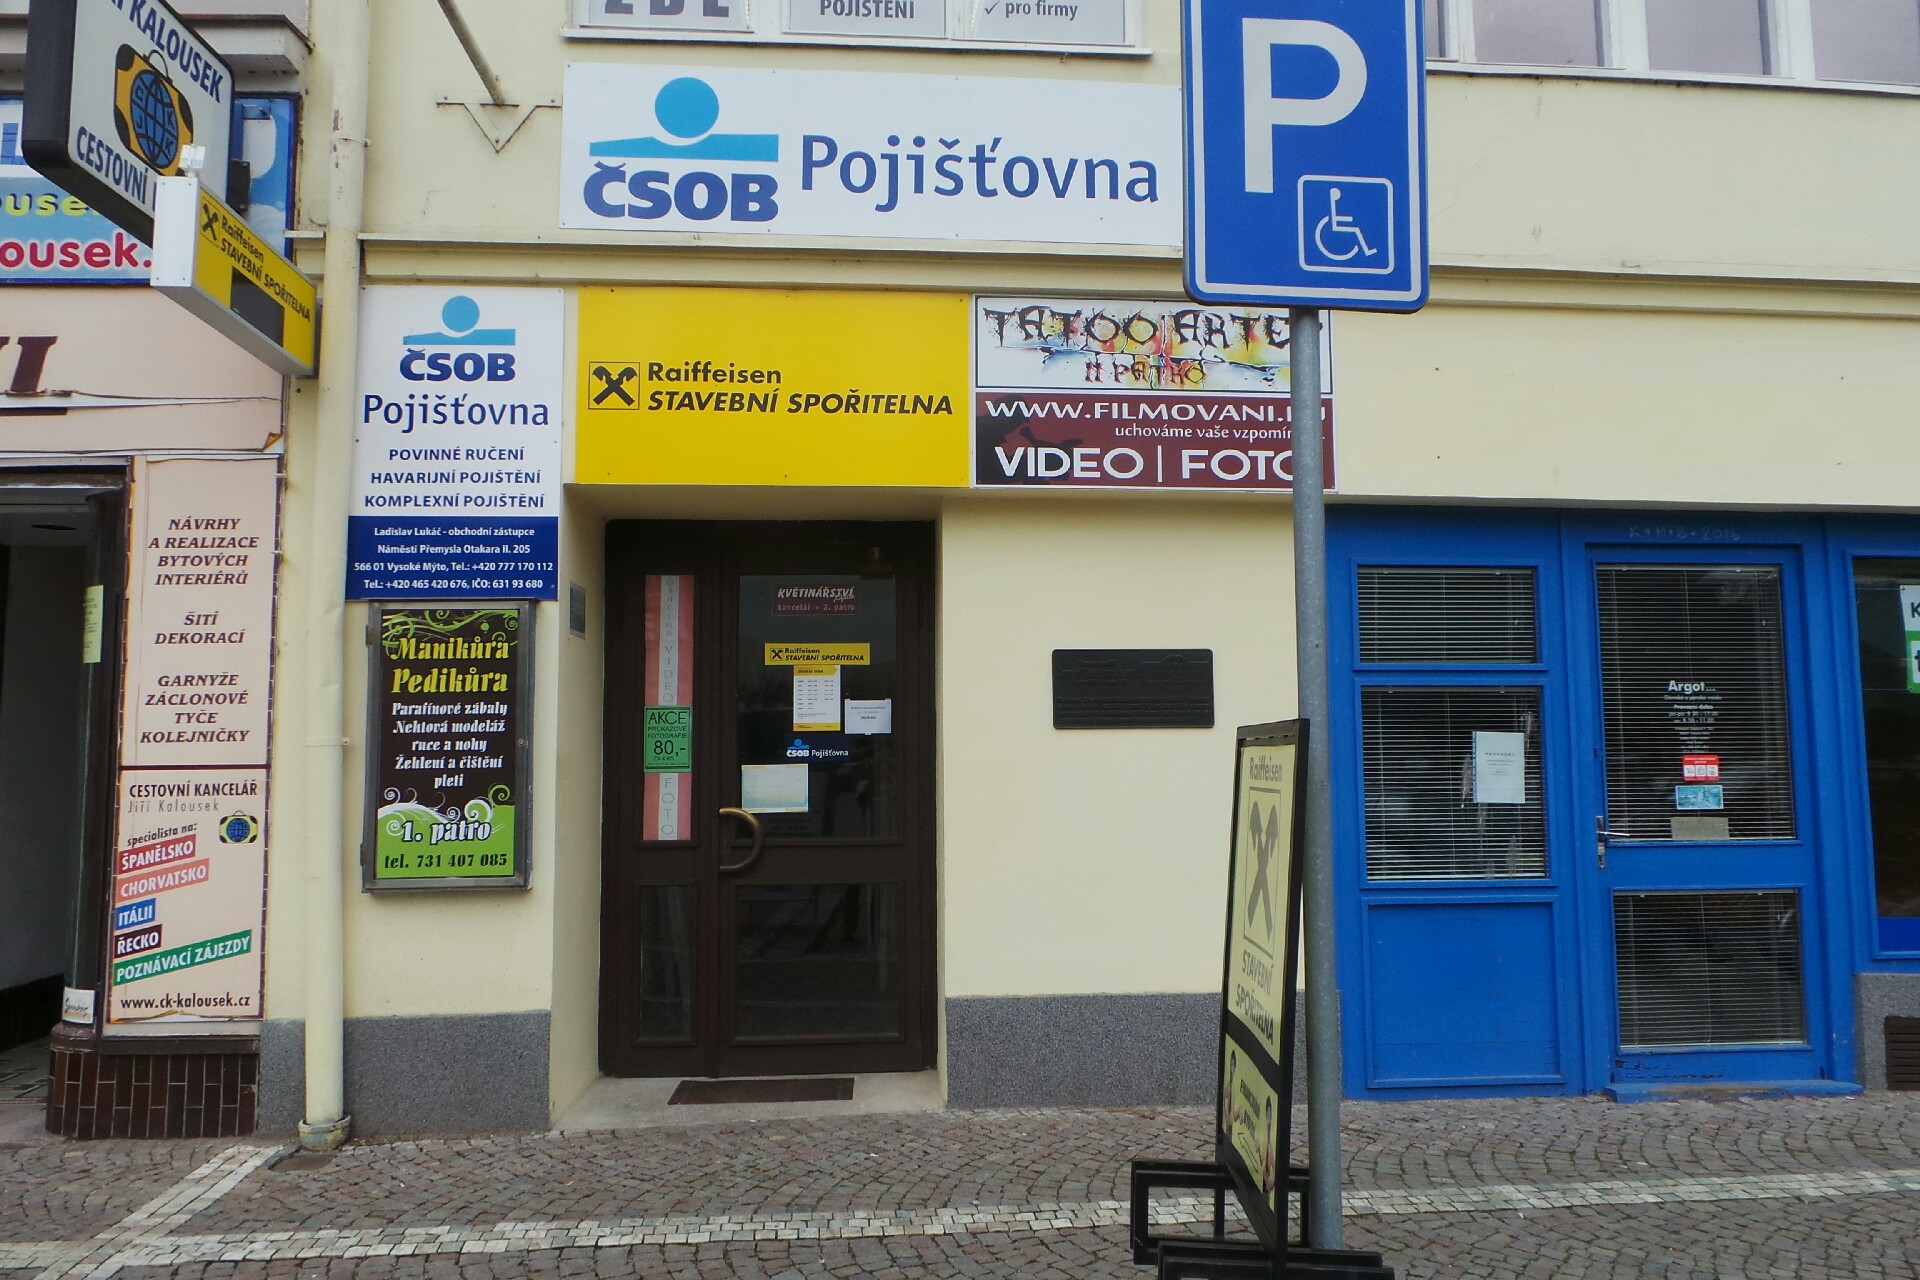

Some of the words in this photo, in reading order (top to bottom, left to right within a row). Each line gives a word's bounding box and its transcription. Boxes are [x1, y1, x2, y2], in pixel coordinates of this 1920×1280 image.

[1005, 2, 1032, 18] pro
[1036, 0, 1078, 21] firmy
[128, 0, 223, 104] KALOUSEK
[1242, 18, 1368, 194] P
[75, 126, 148, 203] CESTOVNÍ
[801, 134, 1160, 213] Pojišťovna
[583, 161, 779, 222] ČSOB
[221, 214, 265, 264] Raiffeisen
[220, 237, 263, 282] STAVEBNÍ
[263, 273, 312, 323] SPOŘITELNA
[983, 306, 1159, 349] TATOO
[399, 347, 516, 382] ČSOB
[647, 360, 783, 385] Raiffeisen
[647, 387, 780, 413] STAVEBNÍ
[787, 388, 955, 416] SPOŘITELNA
[363, 393, 549, 434] Pojišťovna
[984, 400, 1326, 423] WWW.FILMOVANI.
[1115, 422, 1193, 438] uchováme
[1196, 424, 1231, 439] vaše
[388, 446, 461, 461] POVINNÉ
[465, 445, 525, 461] RUČENÍ
[994, 446, 1144, 481] VIDEO
[370, 469, 456, 484] HAVARIJNÍ
[459, 469, 541, 485] POJIŠTĚNÍ
[364, 492, 460, 508] KOMPLEXNÍ
[463, 493, 545, 508] POJIŠTĚNÍ
[168, 515, 241, 531] NÁVRHY
[374, 527, 413, 536] Ladislav
[414, 527, 442, 536] Lukáč
[448, 527, 492, 536] obchodní
[493, 527, 535, 539] zástupce
[148, 537, 160, 549] A
[164, 536, 259, 549] REALIZACE
[377, 544, 418, 554] Náměstí
[420, 544, 462, 556] Přemysla
[463, 544, 500, 554] Otakara
[513, 545, 531, 554] 205
[157, 551, 249, 567] BYTOVÝCH
[354, 562, 372, 571] 566
[373, 562, 385, 571] 01
[387, 562, 421, 574] Vysoké
[422, 562, 450, 574] Mýto,
[451, 562, 470, 571] Tel.:
[472, 562, 496, 571] +420
[497, 562, 515, 571] 777
[517, 562, 535, 571] 170
[536, 562, 554, 571] 112
[154, 569, 249, 585] INTERIÉRŮ
[364, 580, 384, 589] Tel.:
[385, 579, 410, 589] +420
[412, 579, 430, 589] 465
[430, 579, 449, 589] 420
[450, 579, 470, 590] 676,
[472, 578, 491, 589] IČO:
[492, 580, 510, 589] 631
[512, 580, 524, 589] 93
[525, 580, 544, 589] 680
[777, 585, 856, 599] KVĚTINÁŘSTVÍ
[183, 610, 219, 626] ŠITÍ
[154, 629, 246, 645] DEKORACÍ
[390, 636, 510, 660] Manikůra
[157, 671, 239, 687] GARNYŽE
[390, 666, 509, 694] Pedikůra
[1668, 680, 1705, 694] Argot
[144, 690, 249, 706] ZÁCLONOVÉ
[174, 709, 219, 724] TYČE
[391, 701, 462, 716] Parafínové
[464, 701, 508, 717] zábaly
[392, 720, 449, 734] Nehtová
[451, 719, 506, 733] modeláž
[647, 711, 688, 725] AKCE
[139, 727, 250, 744] KOLEJNIČKY
[411, 739, 441, 751] ruce
[443, 741, 452, 751] a
[455, 738, 488, 753] nohy
[653, 740, 686, 758] 80,-
[786, 749, 810, 757] ČSOB
[811, 750, 849, 758] Pojišťovna
[394, 754, 446, 770] Žehlení
[447, 759, 456, 769] a
[459, 755, 504, 770] čištění
[1249, 754, 1283, 782] Raiffeisen
[129, 780, 191, 799] CESTOVNÍ
[194, 779, 258, 797] KANCELÁŘ
[434, 774, 464, 789] pleti
[127, 800, 151, 814] Jiří
[158, 799, 220, 813] Kalousek
[127, 826, 178, 848] specialista
[181, 822, 198, 834] na:
[401, 820, 424, 842] 1.
[430, 820, 493, 846] patro
[121, 840, 194, 871] ŠPANĚLSKO
[384, 853, 410, 869] tel.
[417, 854, 442, 868] 731
[448, 854, 474, 867] 407
[480, 853, 508, 867] 085
[120, 865, 208, 898] CHORVATSKO
[118, 904, 154, 928] ITÁLII
[117, 930, 160, 955] ŘECKO
[116, 951, 191, 983] POZNÁVACÍ
[194, 934, 250, 962] ZÁJEZDY
[1241, 948, 1274, 997] STAVEBNÍ
[120, 992, 251, 1009] www.ck-kalousek.cz
[1235, 982, 1274, 1046] SPOŘITELNA
